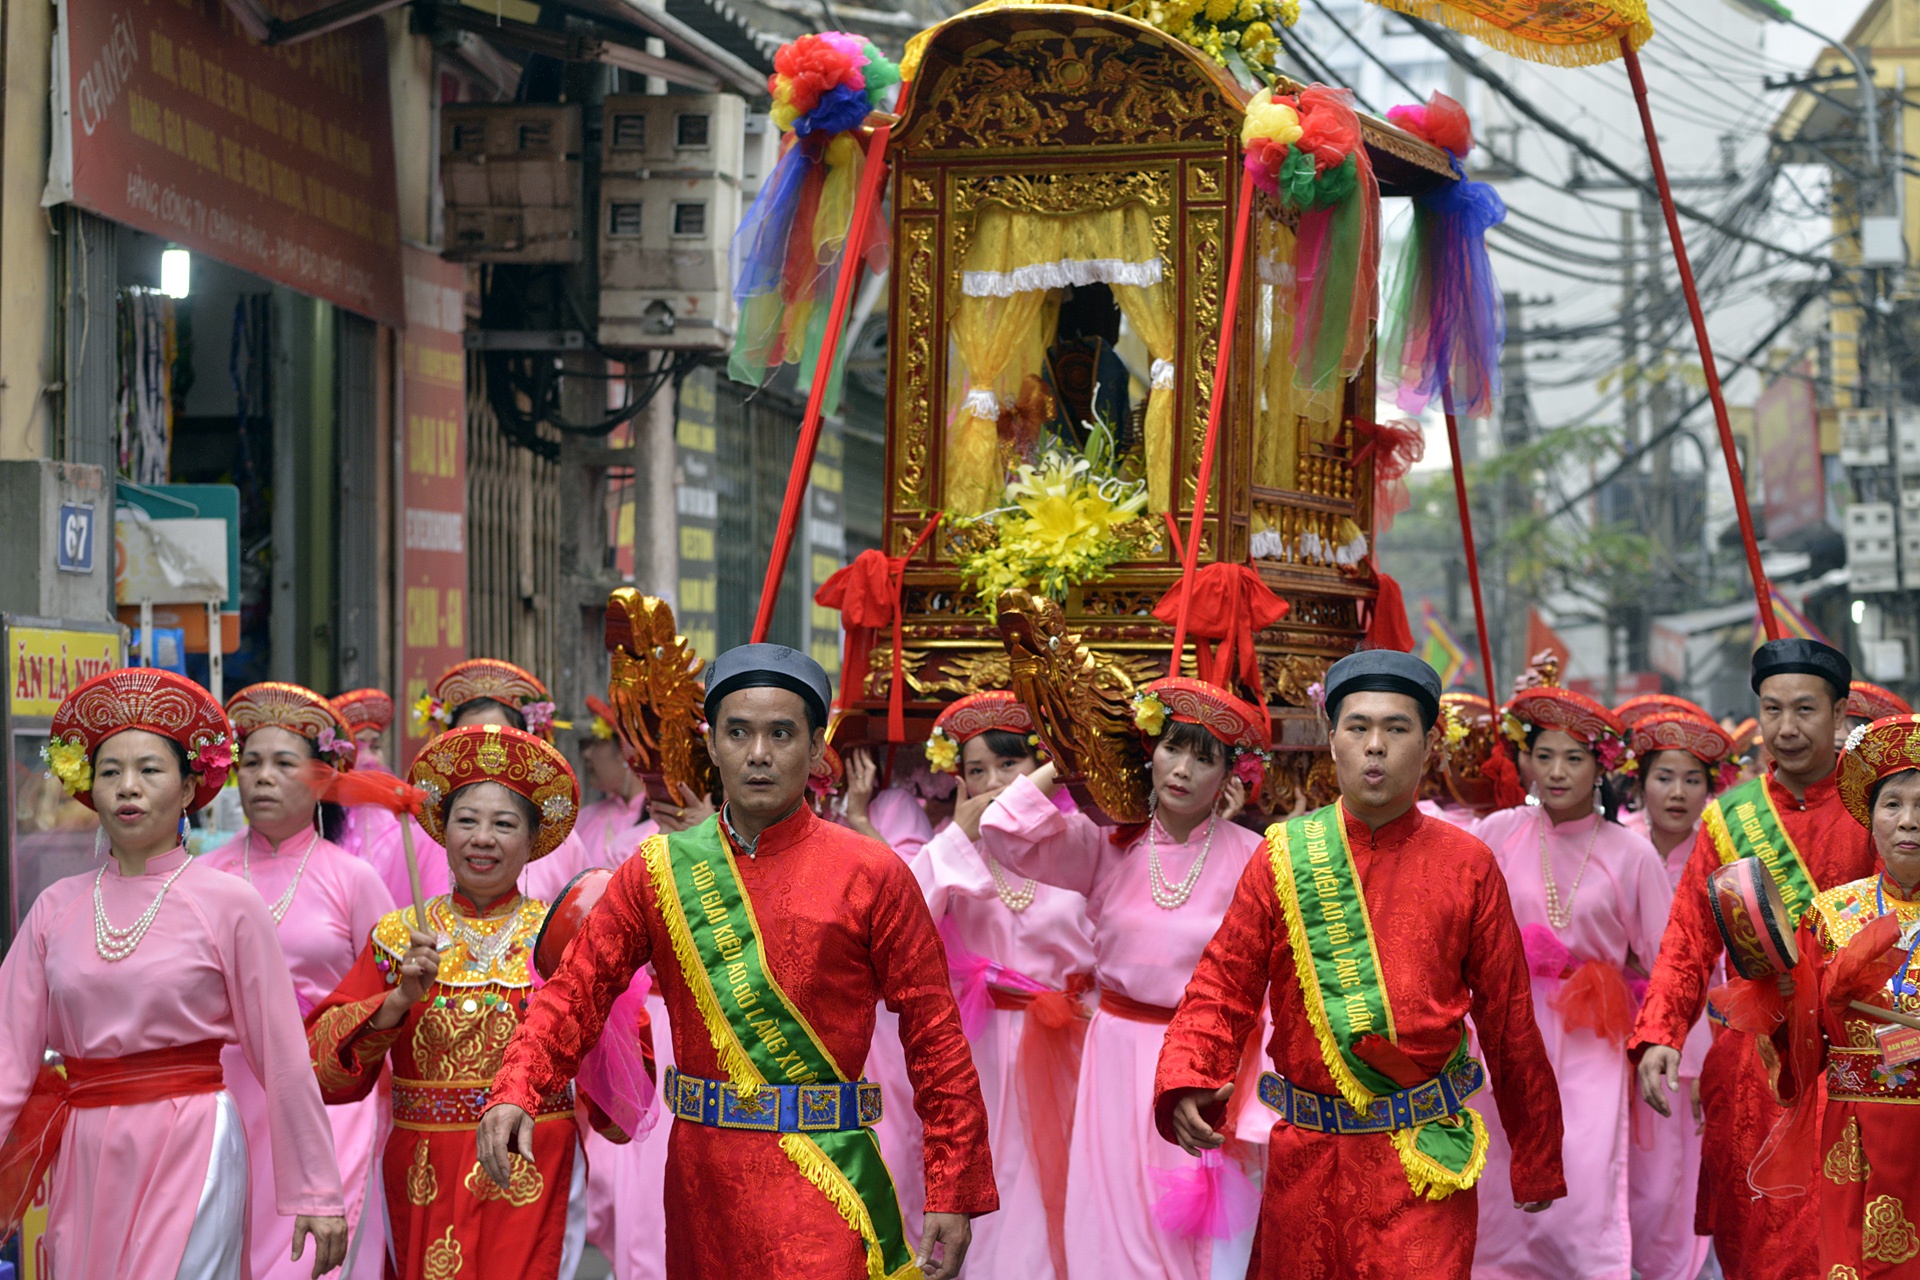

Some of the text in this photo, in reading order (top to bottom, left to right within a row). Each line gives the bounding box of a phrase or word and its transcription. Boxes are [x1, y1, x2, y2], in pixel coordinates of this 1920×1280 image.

[65, 514, 88, 560] 67
[16, 641, 43, 699] ĂN
[47, 643, 70, 700] LÀ
[1742, 817, 1766, 844] GIAI
[1307, 840, 1330, 865] GIAI
[1310, 868, 1339, 899] KIỆU
[701, 890, 729, 925] GIAI
[1320, 901, 1348, 922] ÁO
[712, 923, 743, 962] KIỆU
[1327, 922, 1355, 945] ĐỎ
[726, 962, 748, 985] ÁO
[1332, 948, 1362, 989] LÀNG
[732, 982, 760, 1009] ĐỎ
[1344, 992, 1375, 1034] XUÂN
[745, 1008, 789, 1054] LÀNG
[775, 1050, 819, 1085] XUÂ
